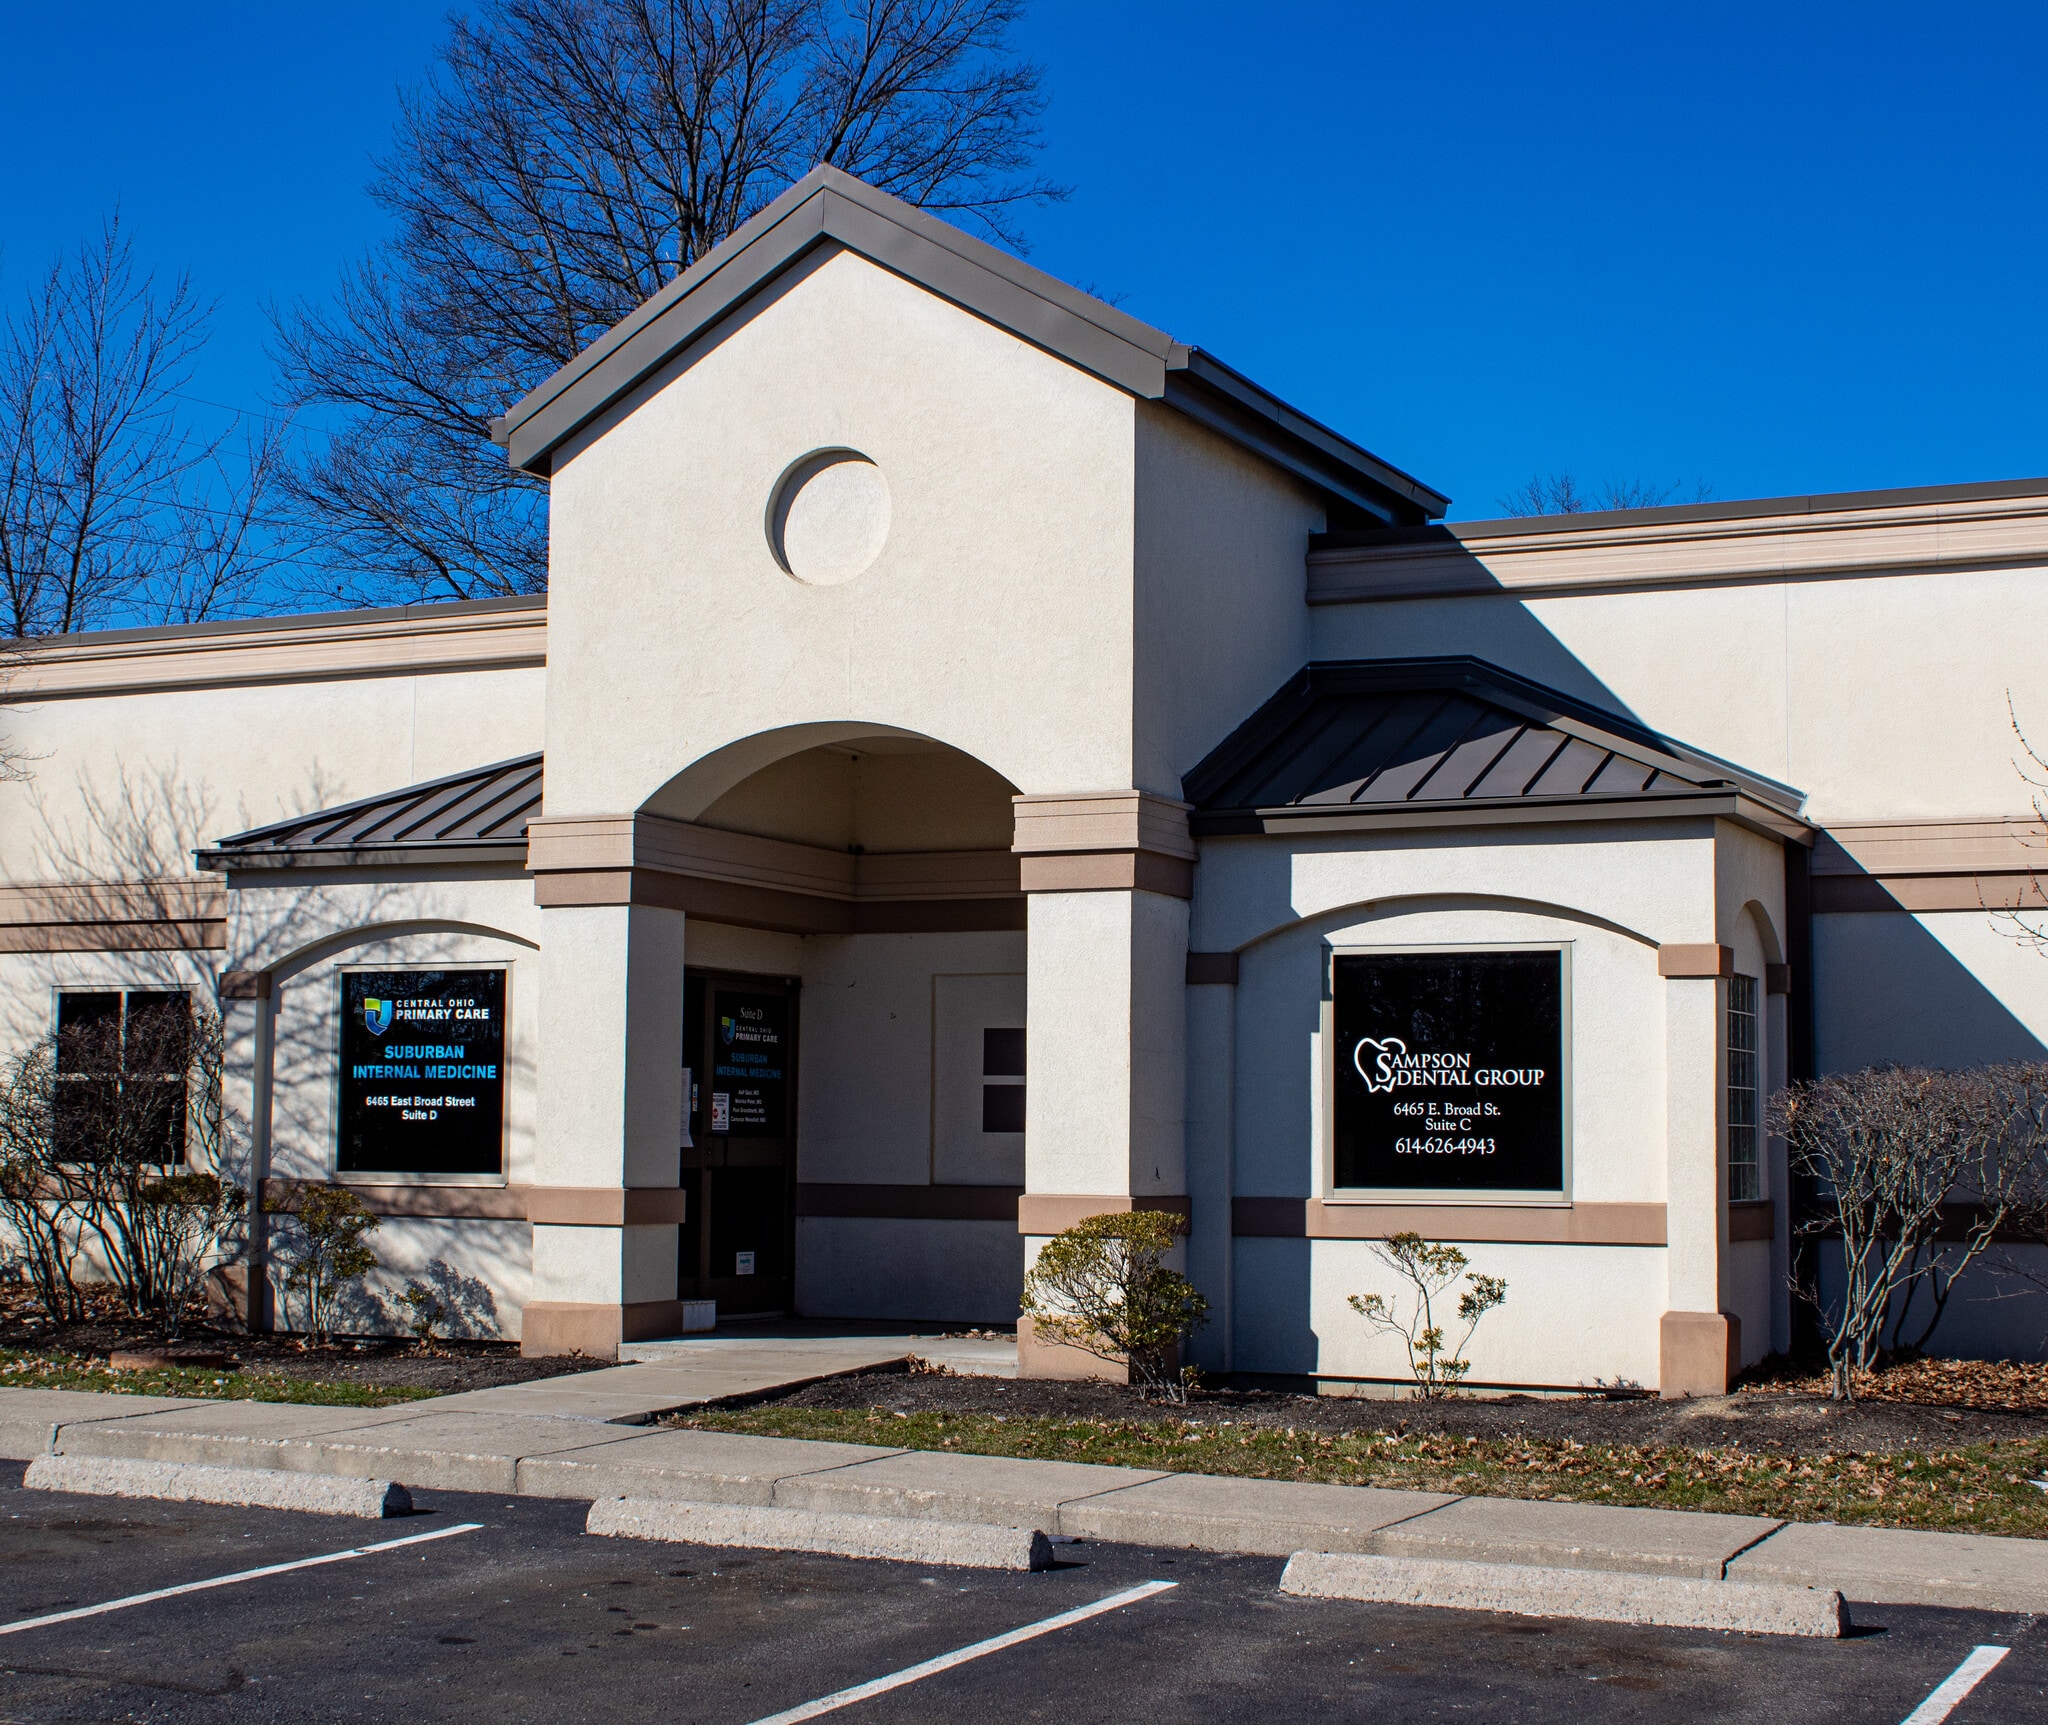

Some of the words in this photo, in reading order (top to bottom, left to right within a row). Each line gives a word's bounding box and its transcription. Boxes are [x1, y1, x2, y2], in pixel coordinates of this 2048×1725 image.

[396, 999, 444, 1008] CENTRAL
[449, 999, 475, 1007] OHIO
[396, 1009, 452, 1020] PRIMARY
[455, 1009, 489, 1020] CARE
[740, 1007, 756, 1020] Suite
[757, 1009, 763, 1020] D
[735, 1025, 758, 1033] CENTRAL
[735, 1032, 761, 1042] PRIMARY
[762, 1035, 778, 1043] CARE
[384, 1045, 465, 1059] SUBURBAN
[731, 1052, 767, 1064] SUBURBAN
[353, 1065, 421, 1079] INTERNAL
[424, 1065, 497, 1079] MEDICINE
[716, 1065, 748, 1077] INTERNAL
[749, 1067, 781, 1079] MEDICINE
[1375, 1052, 1471, 1082] SAMPSON
[1396, 1069, 1471, 1086] DENTAL
[1474, 1069, 1545, 1086] GROUP
[366, 1096, 389, 1106] 6465
[391, 1096, 412, 1106] East
[414, 1096, 443, 1106] Broad
[445, 1096, 475, 1107] Street
[401, 1110, 427, 1120] Suite
[429, 1110, 438, 1120] D
[1394, 1102, 1424, 1116] 6465
[1428, 1102, 1441, 1116] E.
[1444, 1102, 1481, 1116] Broad
[1484, 1102, 1501, 1116] St.
[1425, 1118, 1457, 1131] Suite
[1459, 1118, 1472, 1131] C
[1395, 1137, 1496, 1155] 614-626-4943
